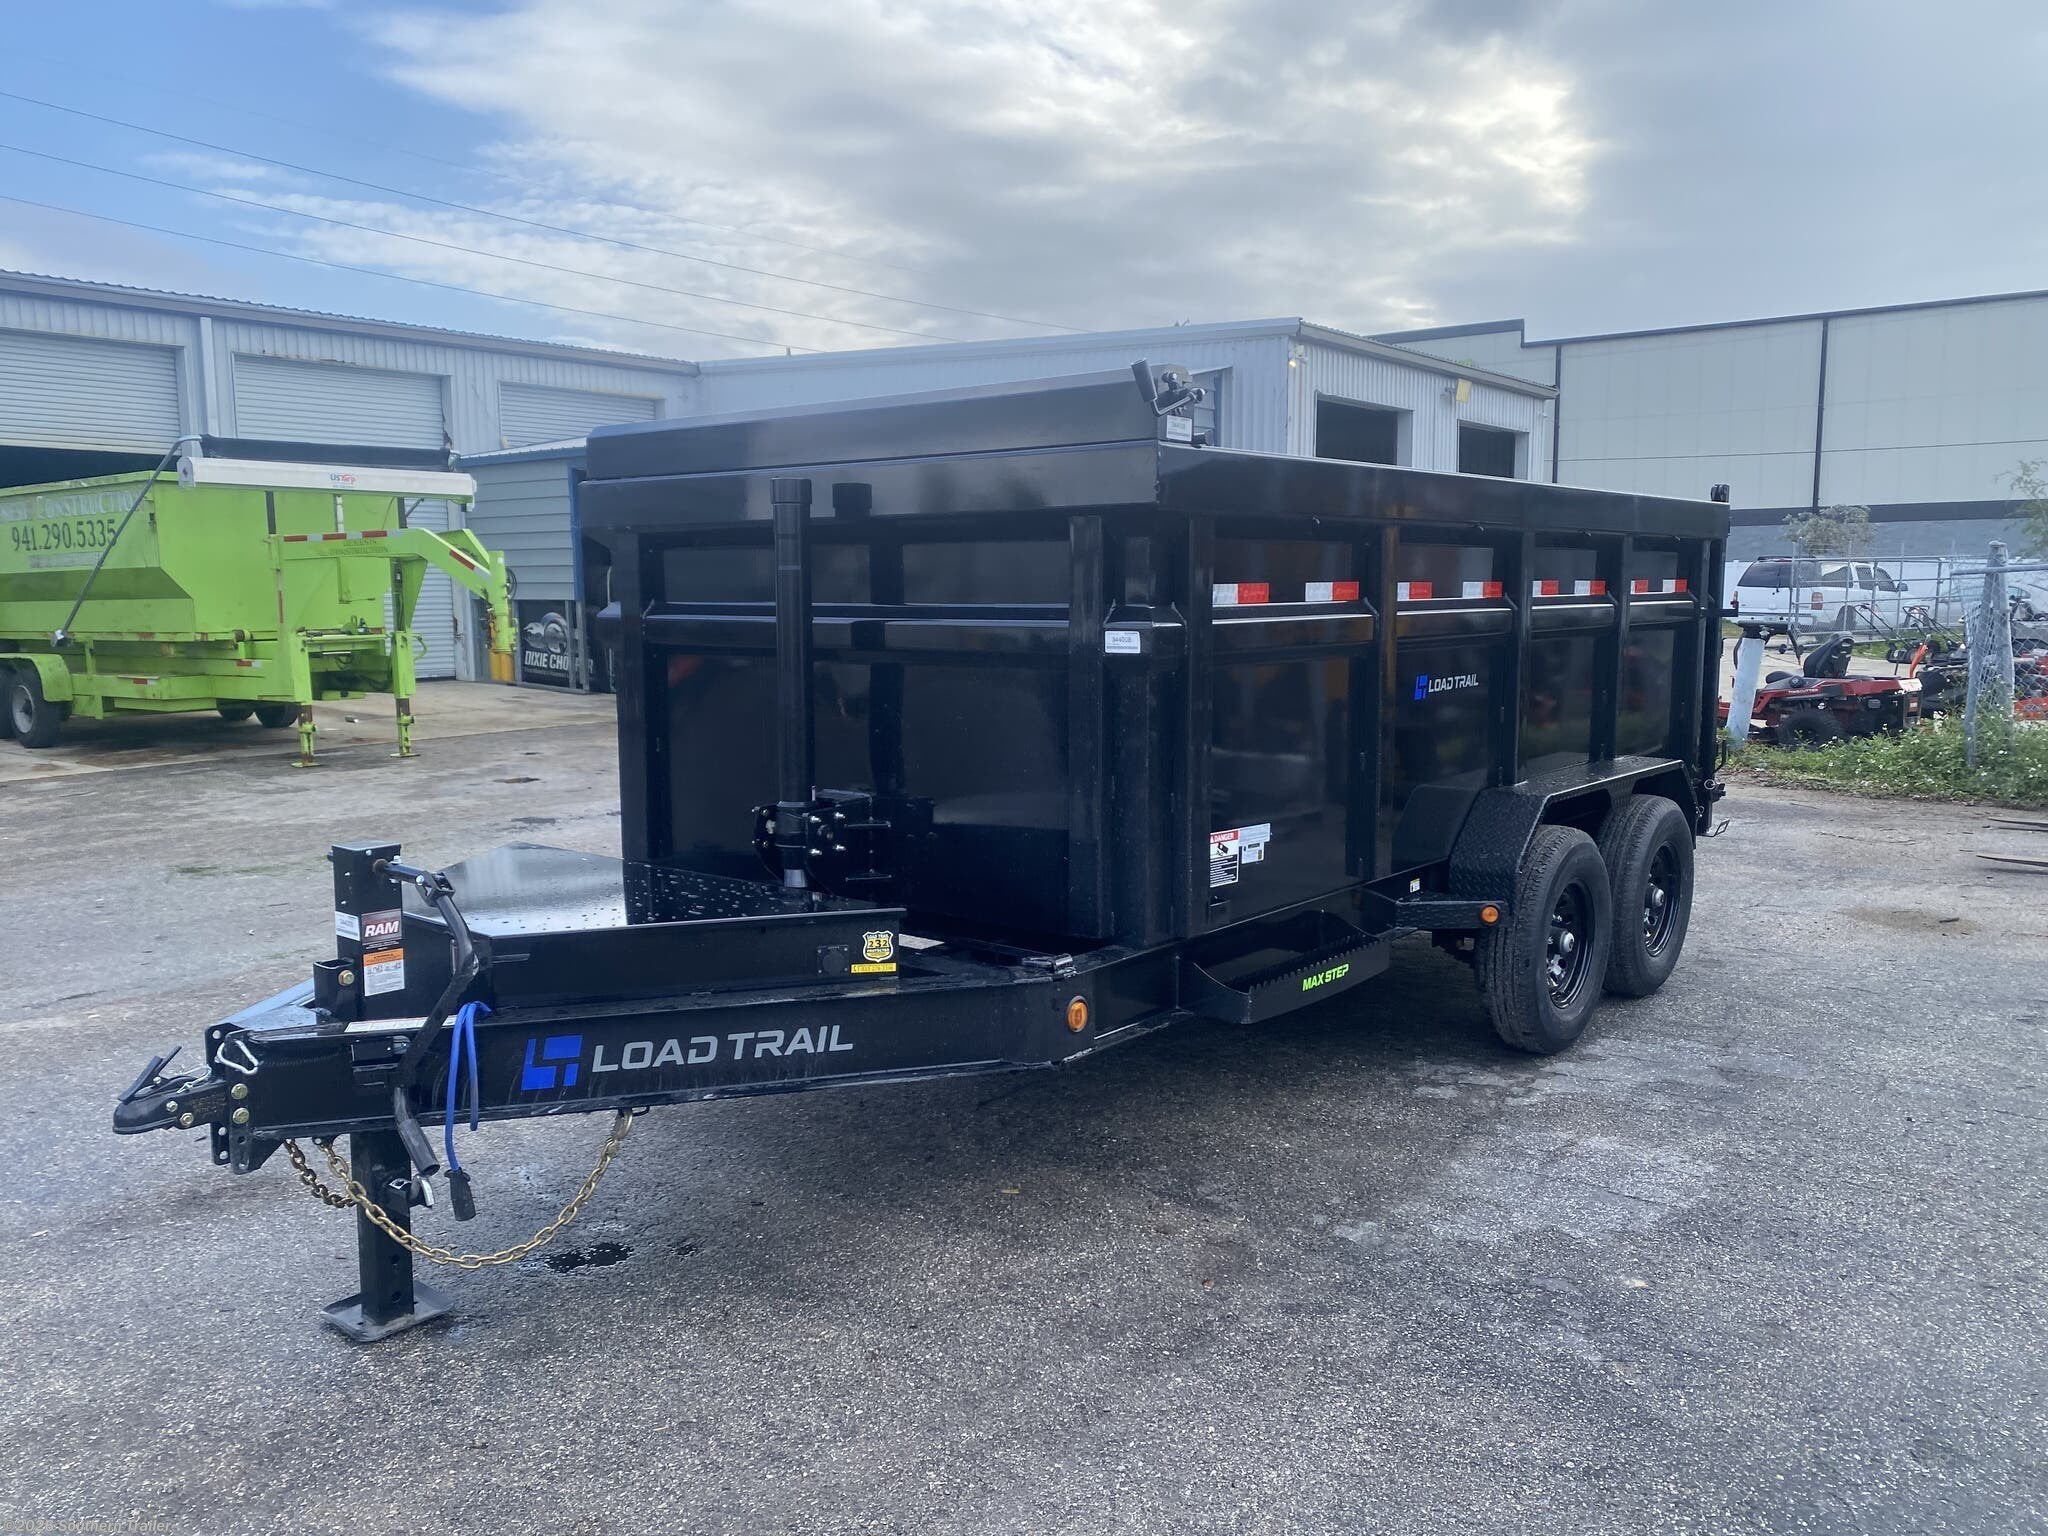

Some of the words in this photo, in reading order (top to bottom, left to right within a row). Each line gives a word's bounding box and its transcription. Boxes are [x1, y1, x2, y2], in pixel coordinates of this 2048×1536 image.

[12, 518, 116, 552] 941.290.5335
[524, 650, 549, 668] DIXIE
[1428, 677, 1454, 693] LOAD
[1454, 673, 1479, 689] TRAIL
[364, 920, 399, 938] RAM
[1302, 972, 1325, 992] MAX
[1324, 963, 1350, 983] STEP
[592, 1035, 718, 1073] LOAD
[727, 1025, 854, 1060] TRAIL
